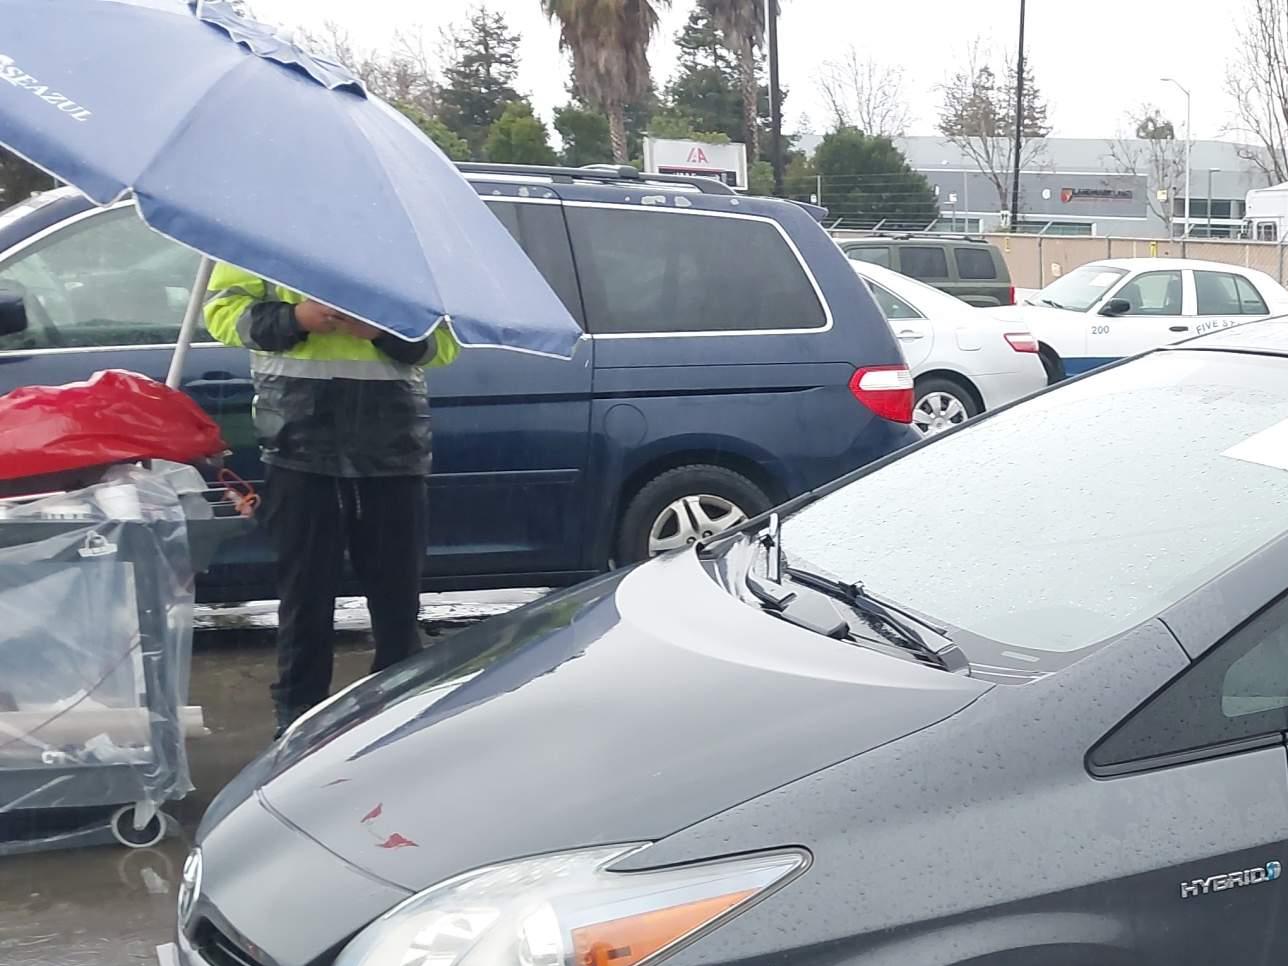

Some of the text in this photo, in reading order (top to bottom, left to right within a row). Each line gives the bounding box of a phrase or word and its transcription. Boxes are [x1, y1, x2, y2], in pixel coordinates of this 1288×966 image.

[1091, 325, 1110, 334] 200
[1195, 319, 1218, 334] FIVE
[1181, 867, 1265, 898] HYBRID
